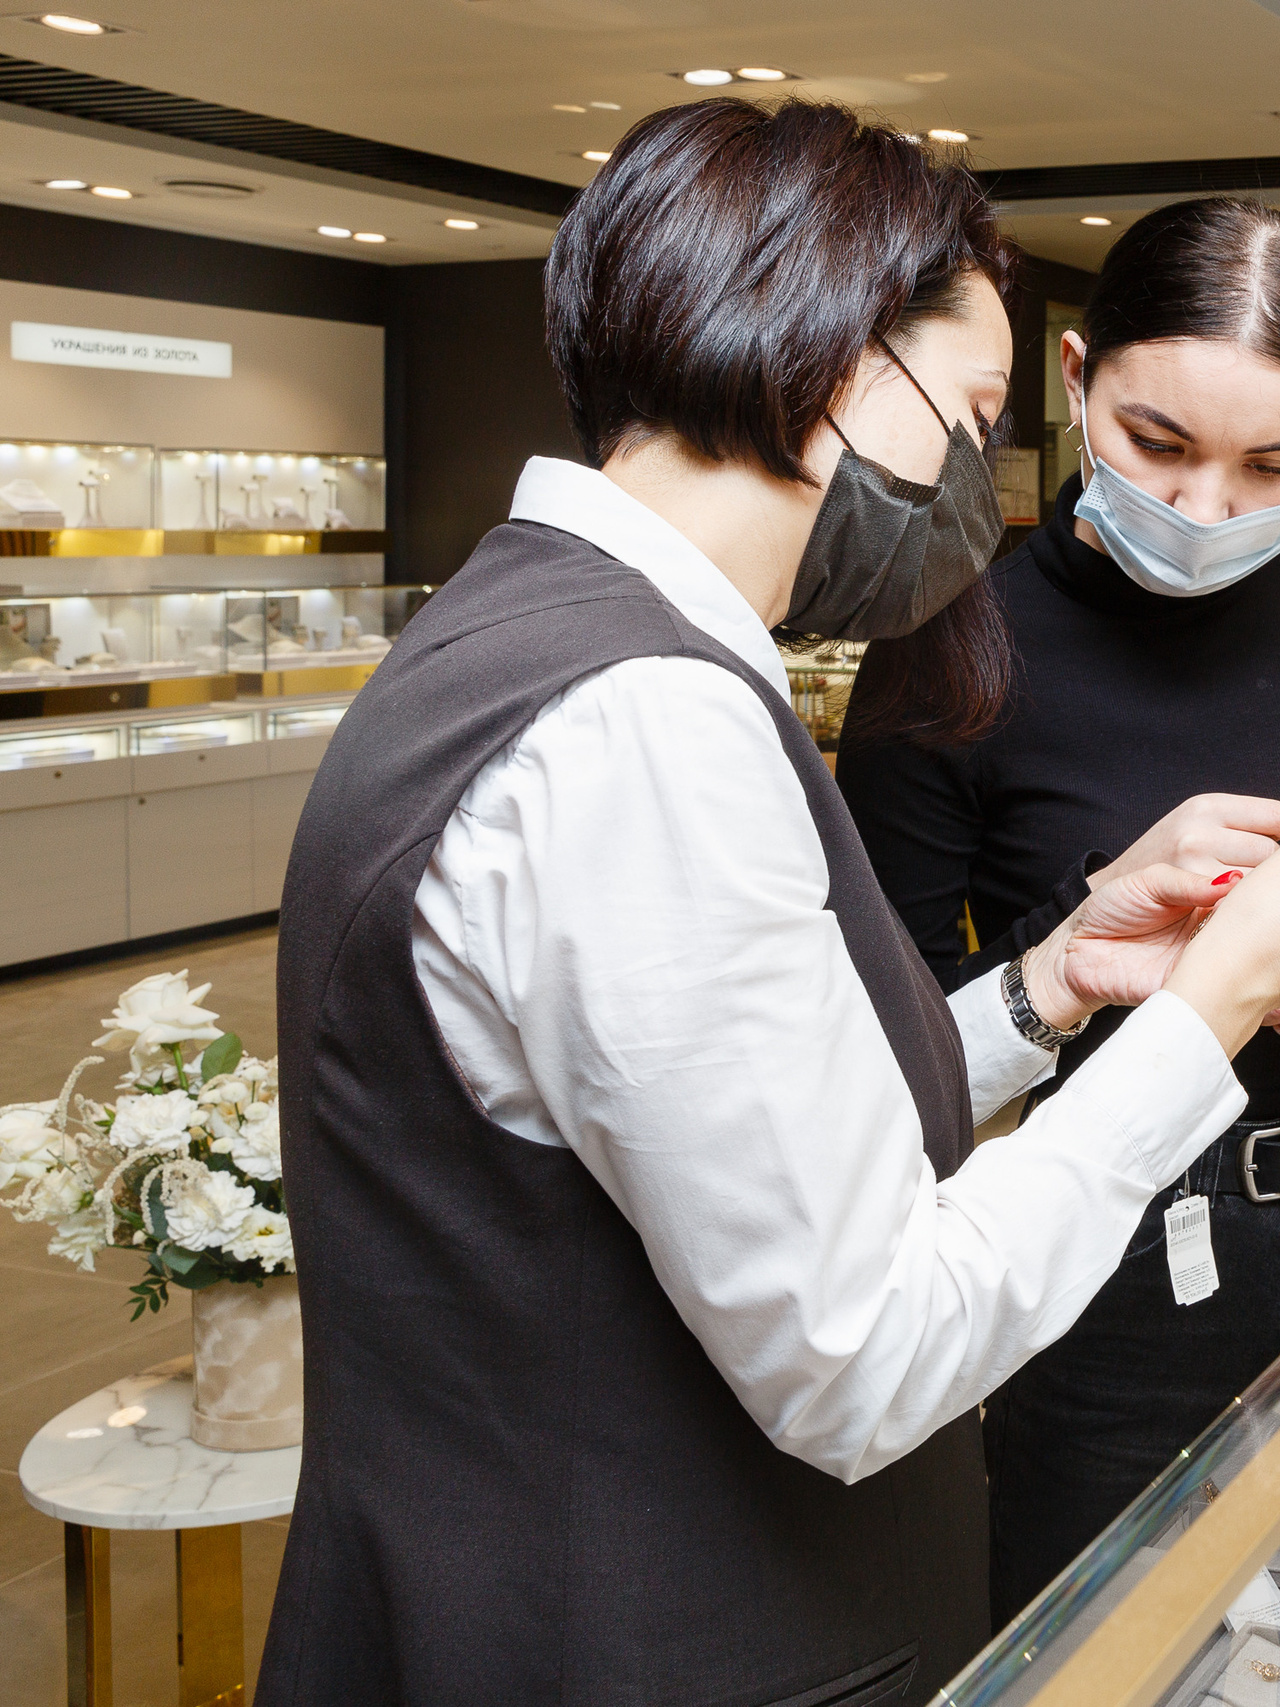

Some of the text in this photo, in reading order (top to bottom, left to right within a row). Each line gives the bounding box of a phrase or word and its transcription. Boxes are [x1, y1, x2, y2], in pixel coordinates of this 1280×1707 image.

[51, 338, 200, 363] УКРАШЕНИЯ ИЗ ЗОЛОТА
